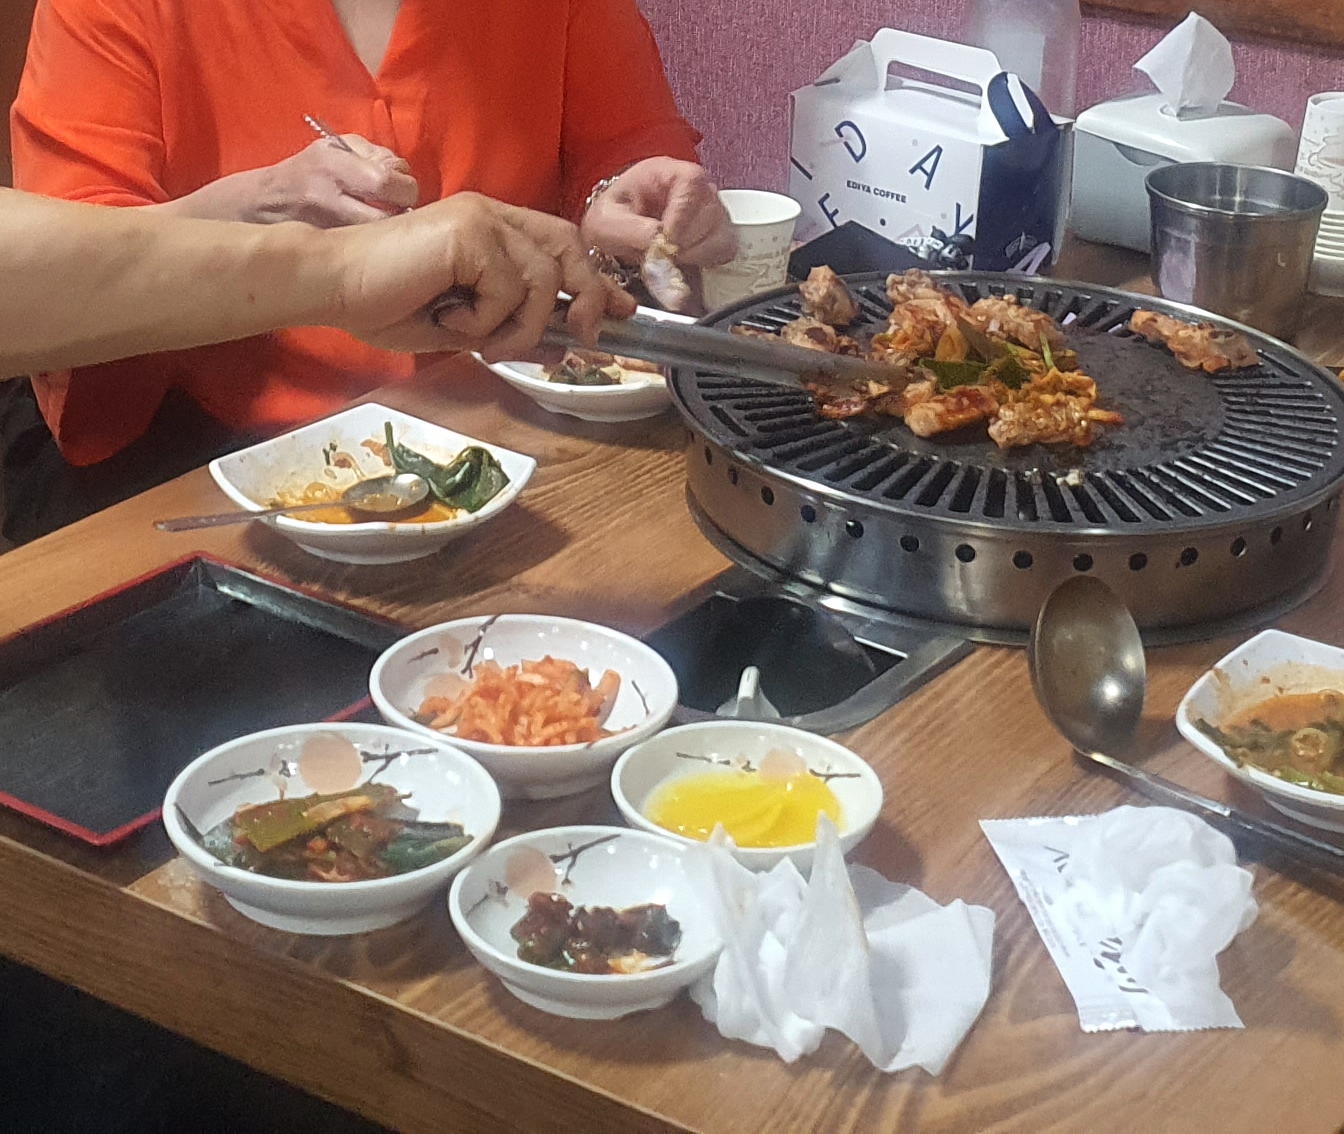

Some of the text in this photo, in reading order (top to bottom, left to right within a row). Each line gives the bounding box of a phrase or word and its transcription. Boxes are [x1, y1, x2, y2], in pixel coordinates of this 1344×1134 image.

[909, 144, 943, 190] A
[847, 179, 907, 204] EDIYA COFFEE
